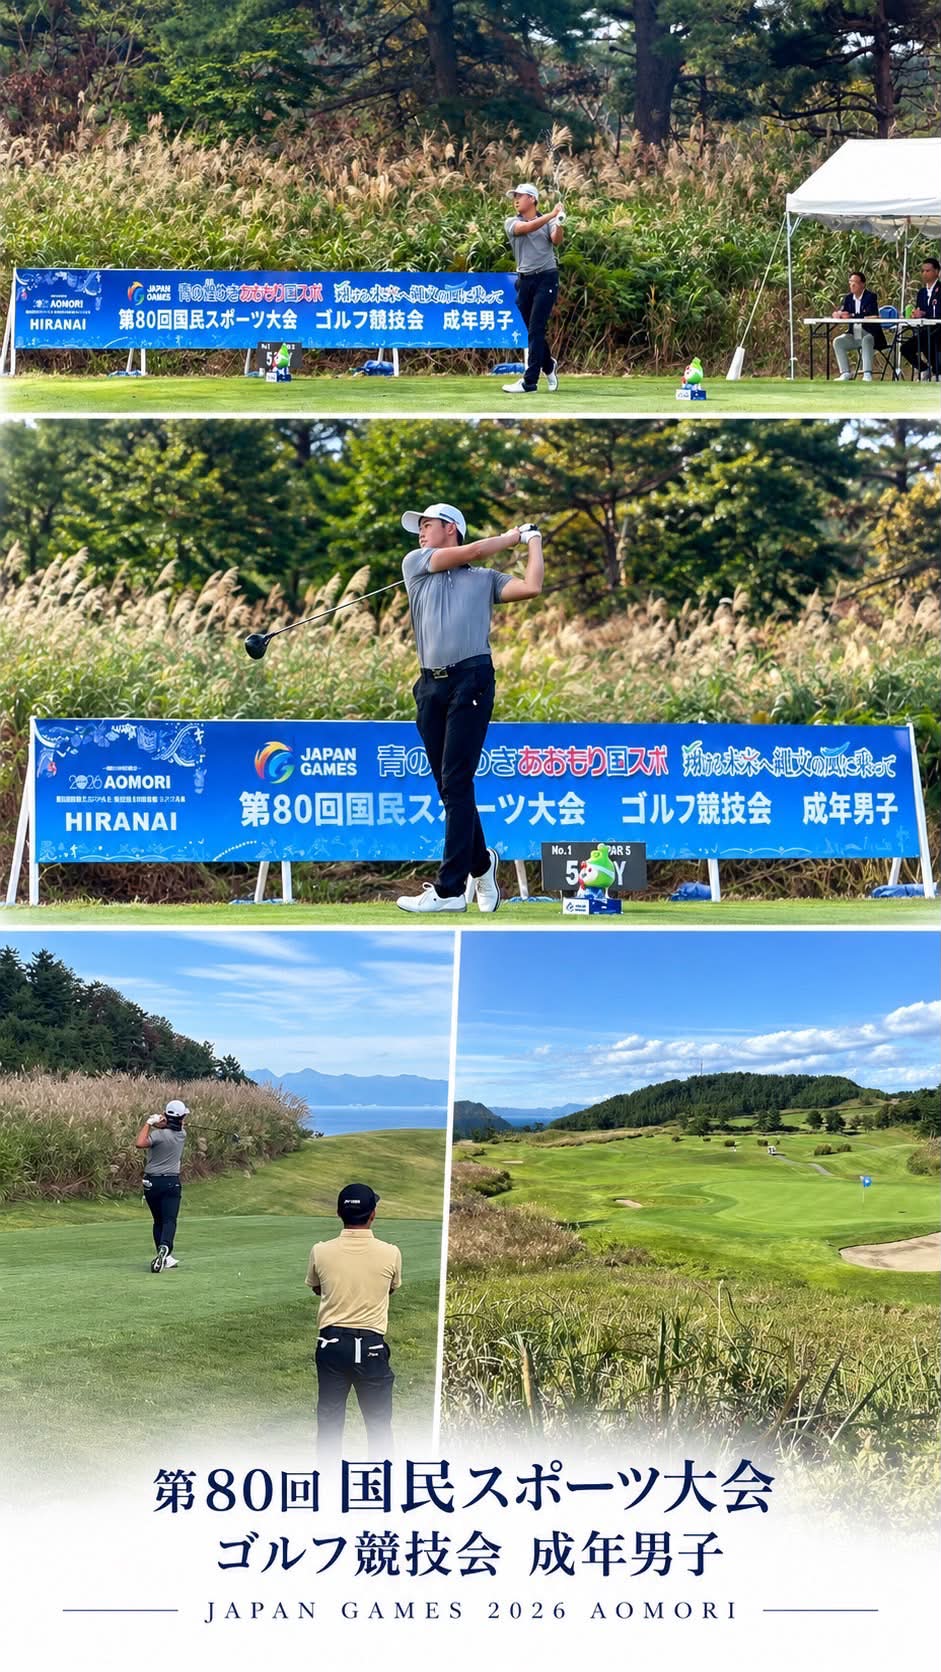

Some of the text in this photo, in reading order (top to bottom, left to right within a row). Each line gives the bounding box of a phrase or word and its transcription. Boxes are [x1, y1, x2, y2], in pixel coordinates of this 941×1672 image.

[147, 284, 171, 292] JAPAN
[30, 318, 86, 330] HIRANAI
[118, 308, 514, 331] 第80回国民スポーツ大会 ゴルフ競技会 成年男子
[300, 747, 356, 761] JAPAN
[300, 762, 357, 776] GAMES
[104, 775, 171, 789] AOMORI
[239, 791, 898, 827] 第80回国民スーツ大会 ゴルフ競技会 成年男子
[65, 812, 177, 832] HIRANAI
[551, 845, 572, 855] No.1
[626, 845, 631, 855] 5
